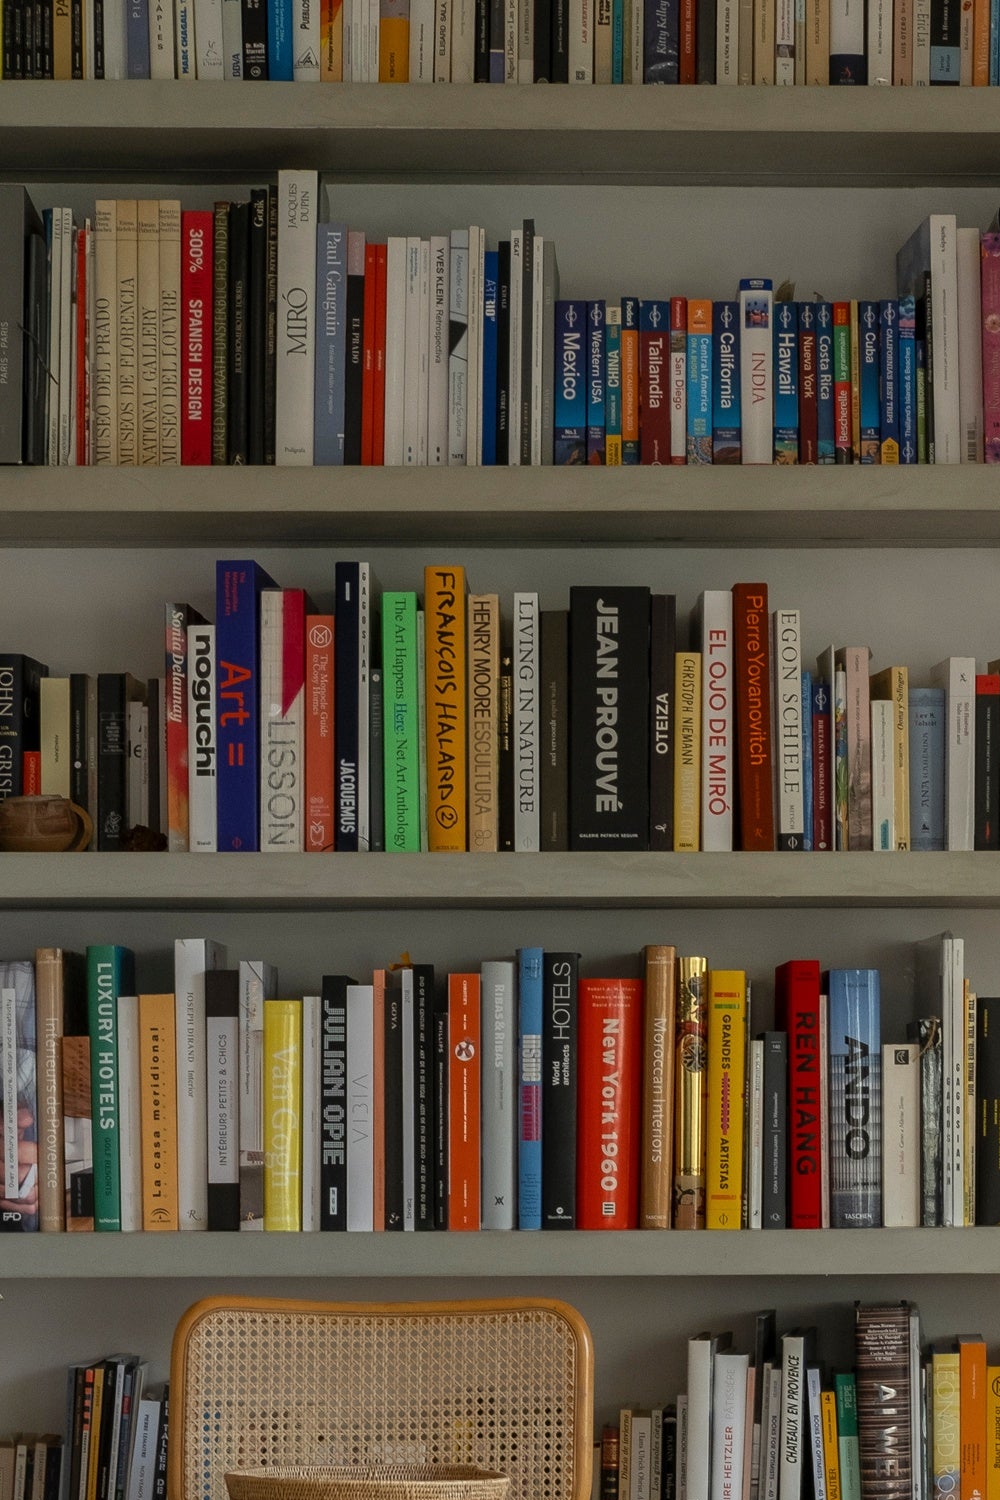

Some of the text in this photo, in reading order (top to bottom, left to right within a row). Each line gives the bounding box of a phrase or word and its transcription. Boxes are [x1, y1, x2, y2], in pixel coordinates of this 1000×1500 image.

[180, 48, 188, 74] MARC
[656, 0, 670, 54] Kitty Kelley
[232, 53, 241, 77] BBVA
[254, 199, 264, 227] Gotik
[288, 183, 299, 229] JACQUES
[300, 191, 309, 222] DUPIN
[321, 231, 342, 337] Paul Gauguin
[435, 247, 444, 274] YVES
[188, 228, 204, 420] 300% SPANISH DESIGN
[282, 288, 308, 356] MIRÓ
[434, 309, 444, 364] Retrospectiva
[95, 297, 111, 463] MUSEO DEL PRADO
[162, 290, 177, 465] MUSEO DEL LOUVRE
[562, 332, 580, 400] Mexico
[648, 338, 663, 408] Tailandia
[673, 357, 684, 410] San Diego
[720, 332, 735, 408] California
[751, 352, 767, 404] INDIA
[778, 333, 794, 395] Hawaii
[395, 597, 407, 622] The
[395, 624, 407, 644] Art
[169, 610, 185, 723] Sonia Delaunay
[220, 660, 252, 728] Art
[393, 647, 408, 700] Happens
[435, 571, 457, 801] FRANÇOIS HALARD
[746, 595, 767, 765] Pierre Yovanovitch
[193, 634, 215, 777] noguchi
[473, 600, 494, 816] HENRY MOORE ESCULTURA
[519, 599, 534, 814] LIVING IN NATURE
[596, 598, 624, 813] JEAN PROUVÉ
[655, 693, 669, 755] OTEIZA
[682, 659, 695, 765] CHRISTOPH NIEMANN
[709, 630, 730, 816] EL OJO DE MIRÓ
[781, 613, 800, 794] EGON SCHIELE
[267, 720, 296, 845] LISSON
[396, 739, 408, 762] Net
[396, 763, 408, 783] Art
[340, 759, 355, 833] JACQUEMUS
[393, 787, 408, 849] Anthology
[390, 1002, 398, 1030] GOYA
[553, 962, 571, 1039] HOTELS
[97, 962, 115, 1130] LUXURY HOTELS
[218, 1034, 227, 1065] CHICS
[552, 1061, 561, 1086] World
[561, 1045, 570, 1086] architects
[721, 1014, 732, 1069] GRANDES
[149, 1027, 162, 1198] La casa meridional
[218, 1078, 228, 1109] PETITS
[323, 1000, 346, 1165] JULIAN OPIE
[601, 1018, 619, 1191] New York 1960
[651, 1018, 667, 1162] Moroccan Interiors
[795, 1012, 817, 1175] REN HANG
[845, 1035, 870, 1160] ANDO
[217, 1112, 228, 1166] INTÉRIEURS
[719, 1138, 730, 1189] ARTISTAS
[785, 1355, 800, 1464] CHATEAUX EN PROVENCE
[873, 1383, 899, 1415] AI
[723, 1426, 733, 1479] HEITZLER
